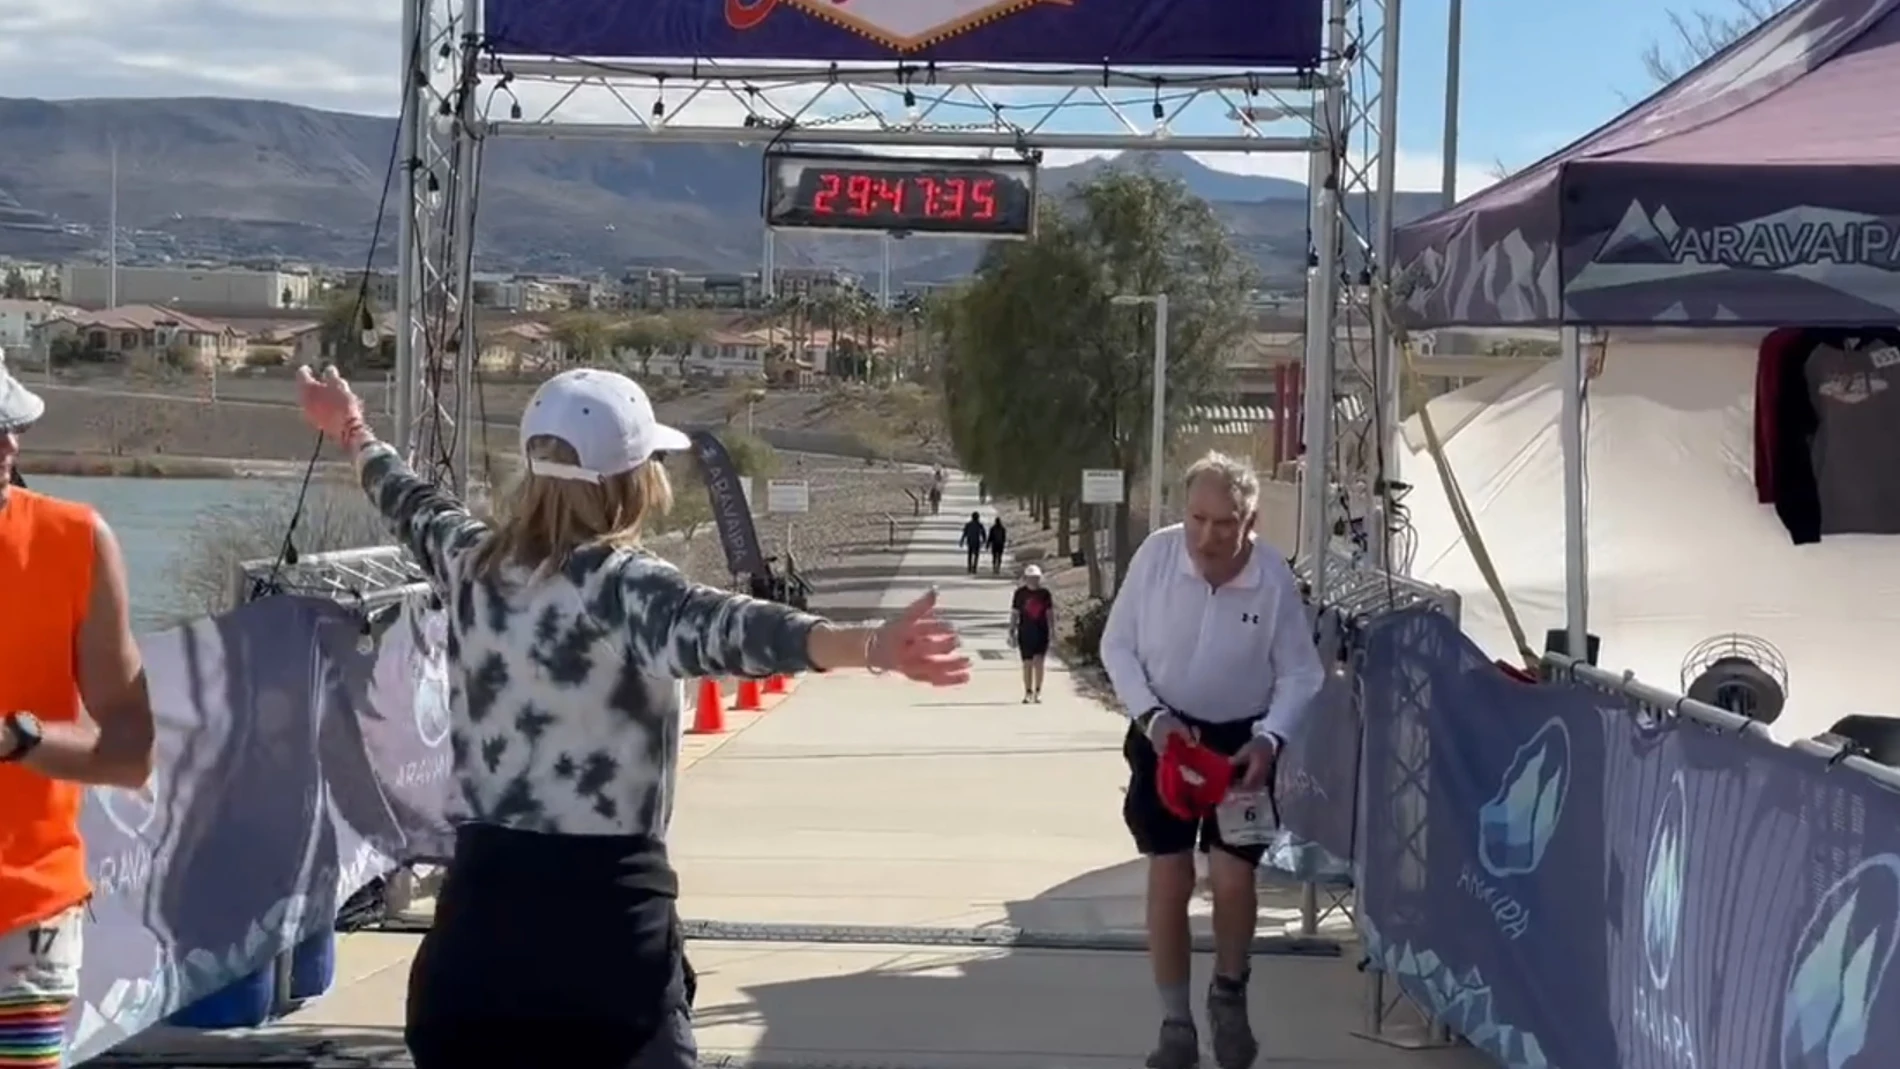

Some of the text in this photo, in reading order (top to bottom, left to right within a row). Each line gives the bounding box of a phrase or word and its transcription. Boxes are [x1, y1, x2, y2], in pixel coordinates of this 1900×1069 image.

[814, 173, 997, 219] 29:47:35
[1244, 807, 1257, 822] 6
[28, 927, 60, 956] 17
